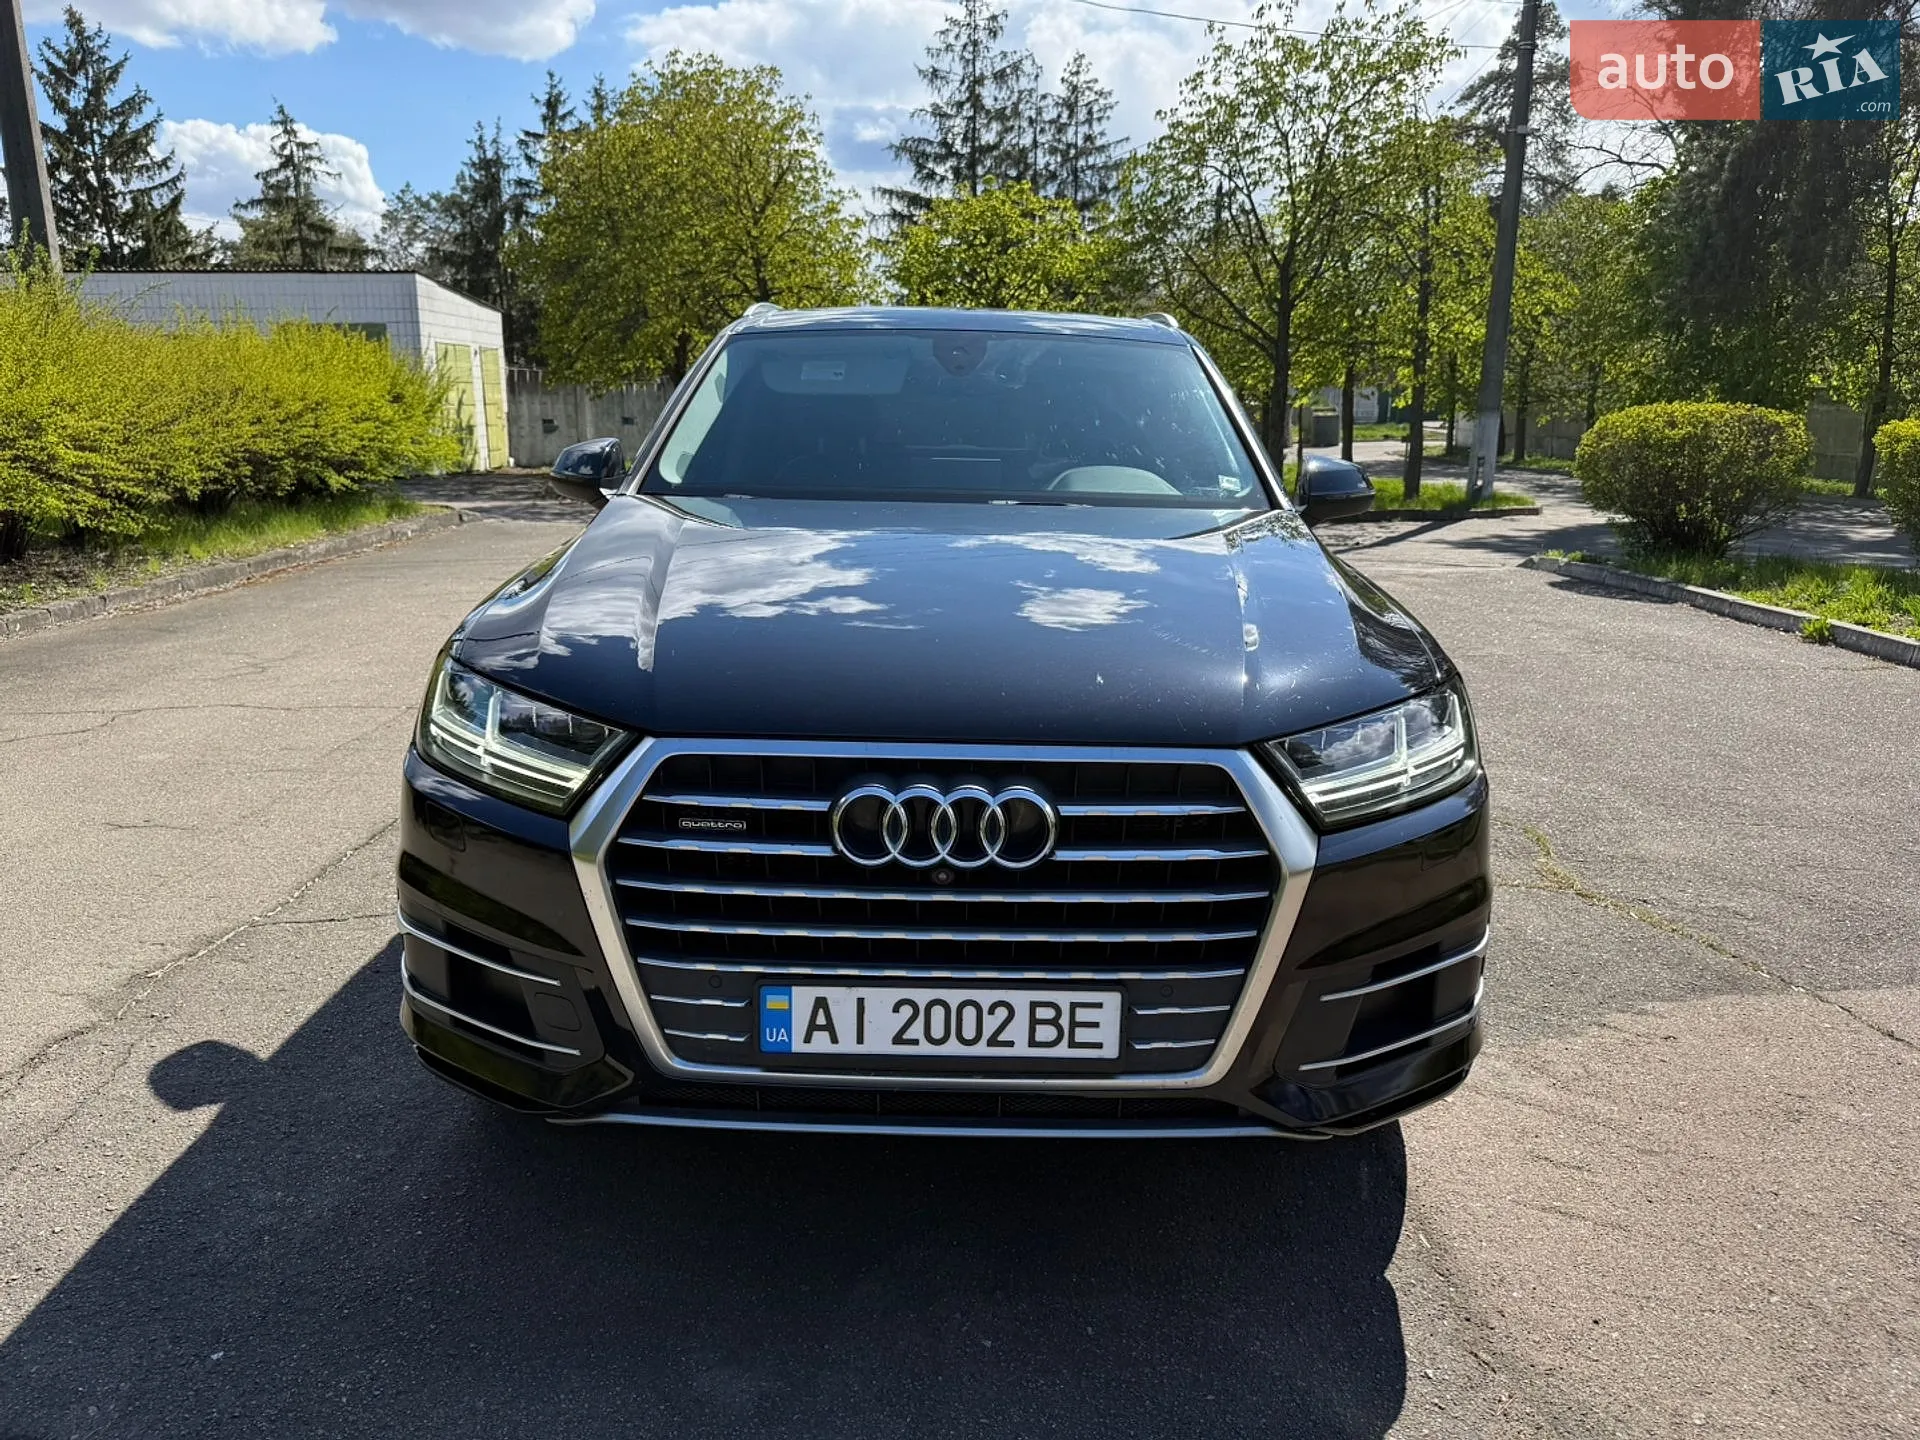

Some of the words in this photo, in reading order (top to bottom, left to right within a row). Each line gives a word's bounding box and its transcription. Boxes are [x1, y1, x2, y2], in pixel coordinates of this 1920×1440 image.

[682, 821, 743, 829] quattro
[891, 998, 1016, 1047] 2002
[766, 1027, 789, 1042] UA
